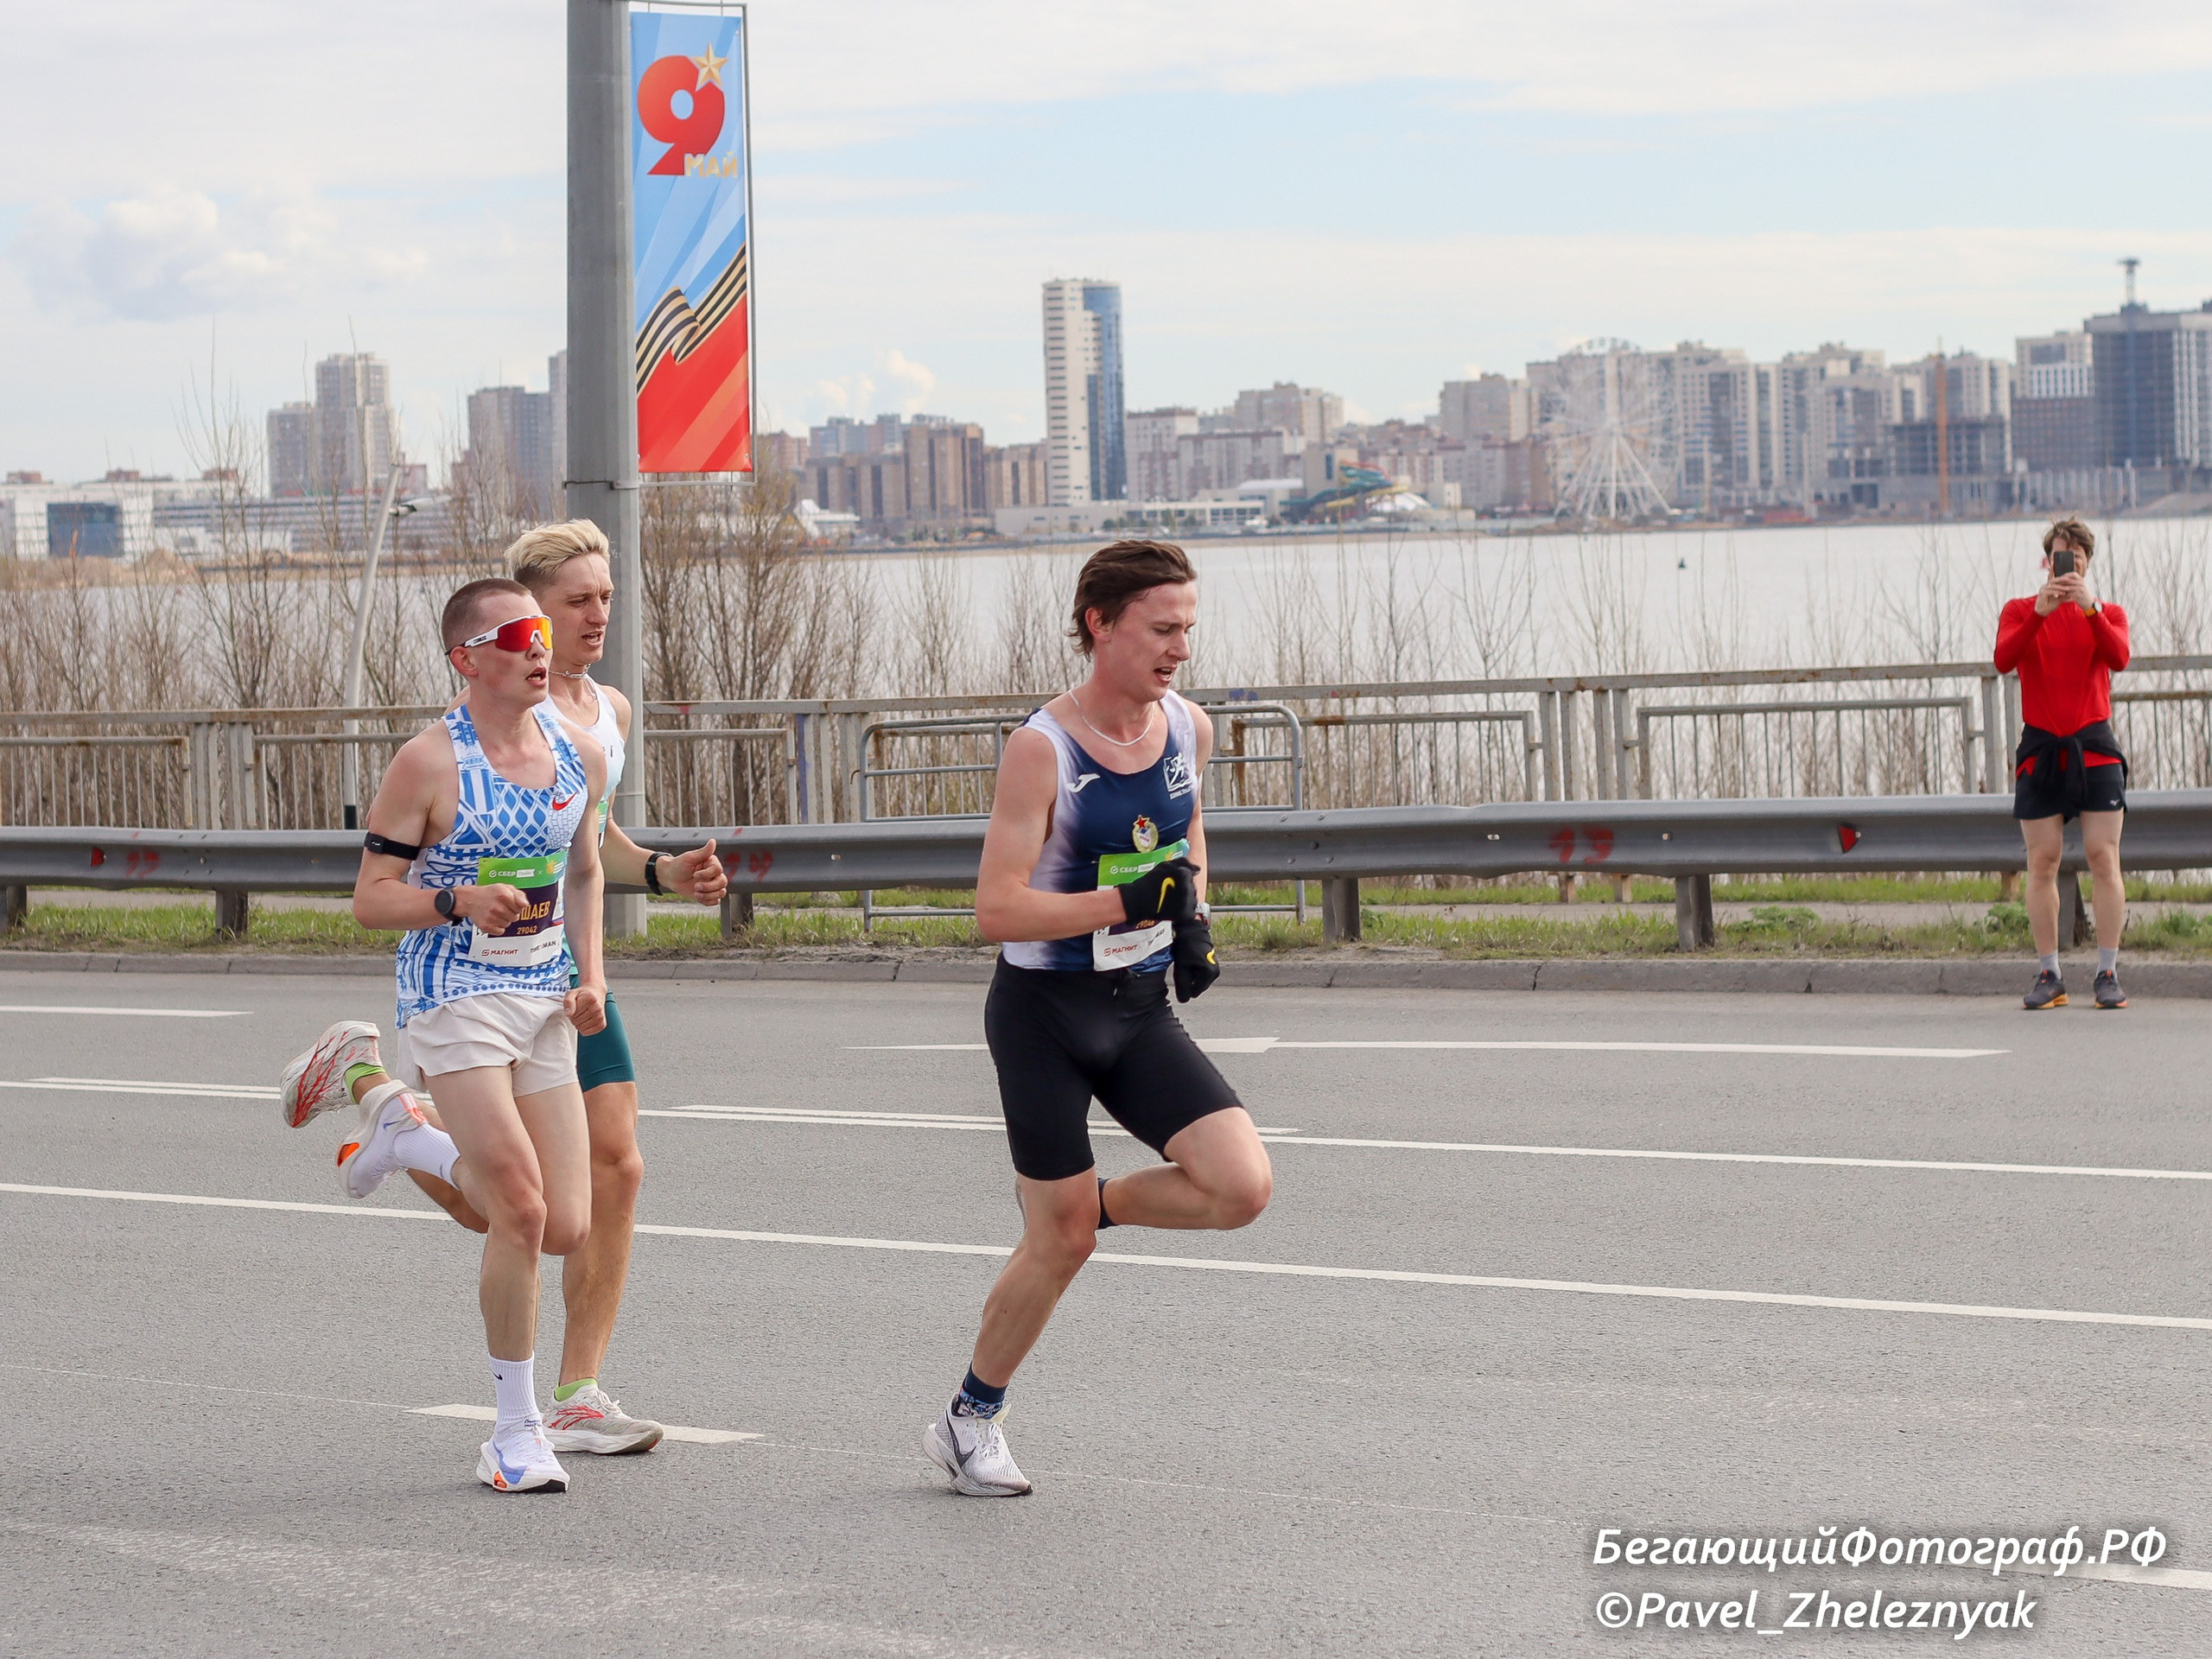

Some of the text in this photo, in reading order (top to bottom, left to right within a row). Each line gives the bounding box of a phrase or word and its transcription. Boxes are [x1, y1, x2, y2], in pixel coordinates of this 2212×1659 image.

[637, 54, 725, 175] 9
[685, 151, 738, 178] МАЙ
[519, 900, 550, 920] ШАЕВ
[517, 925, 537, 935] 29042
